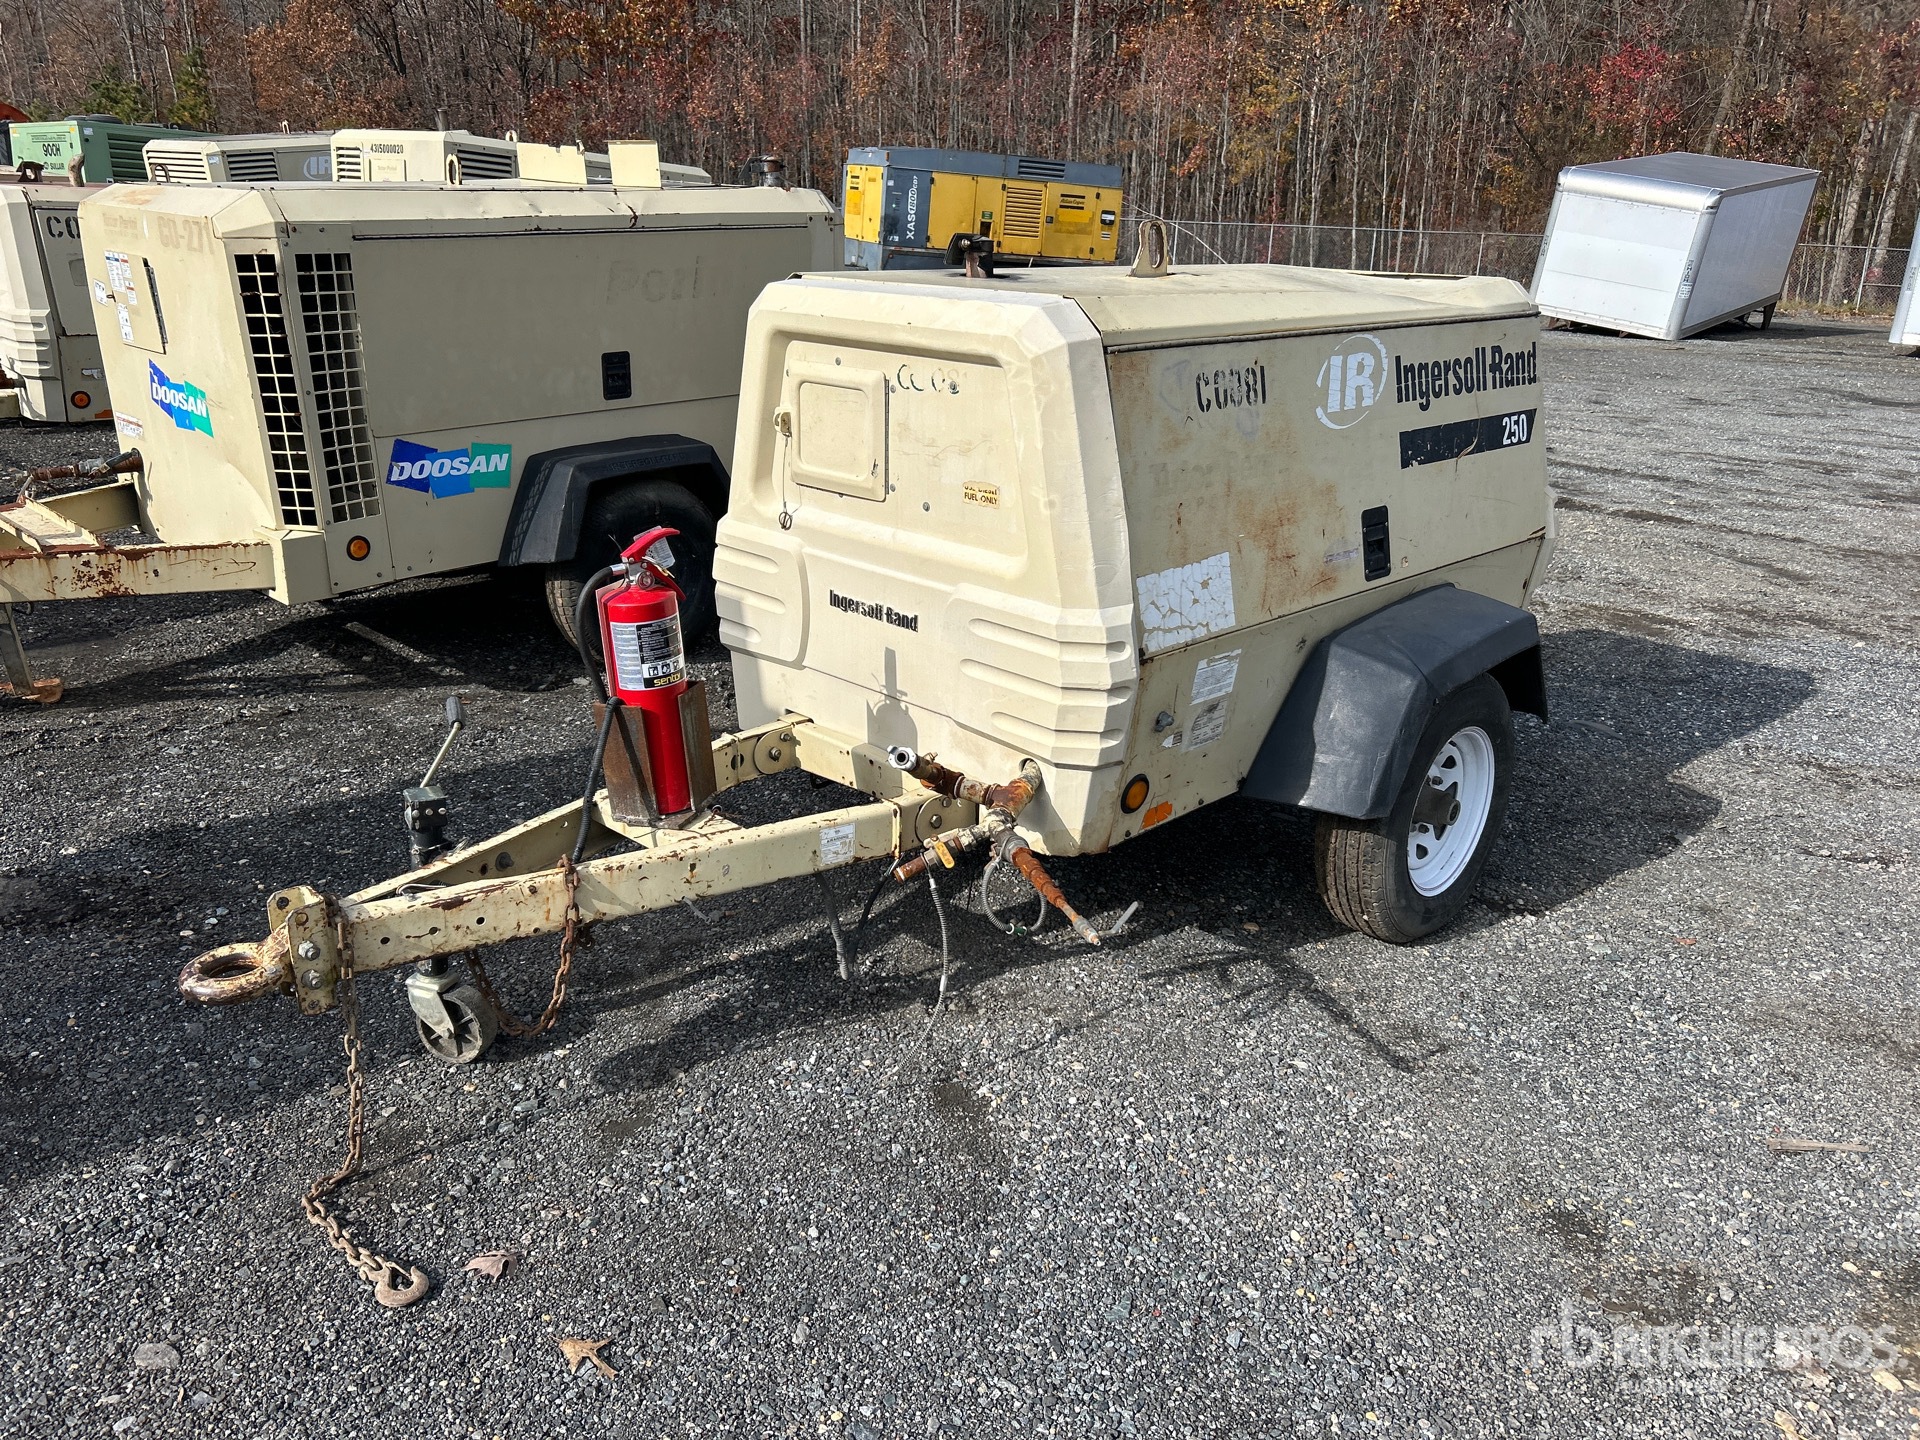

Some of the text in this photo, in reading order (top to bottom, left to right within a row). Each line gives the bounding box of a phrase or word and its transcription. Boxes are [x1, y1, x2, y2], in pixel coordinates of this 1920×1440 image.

[1327, 352, 1375, 413] IR
[152, 382, 207, 418] DOOSAN
[1502, 413, 1528, 445] 250
[391, 453, 509, 481] DOOSAN
[964, 492, 997, 505] FUEL ONLY
